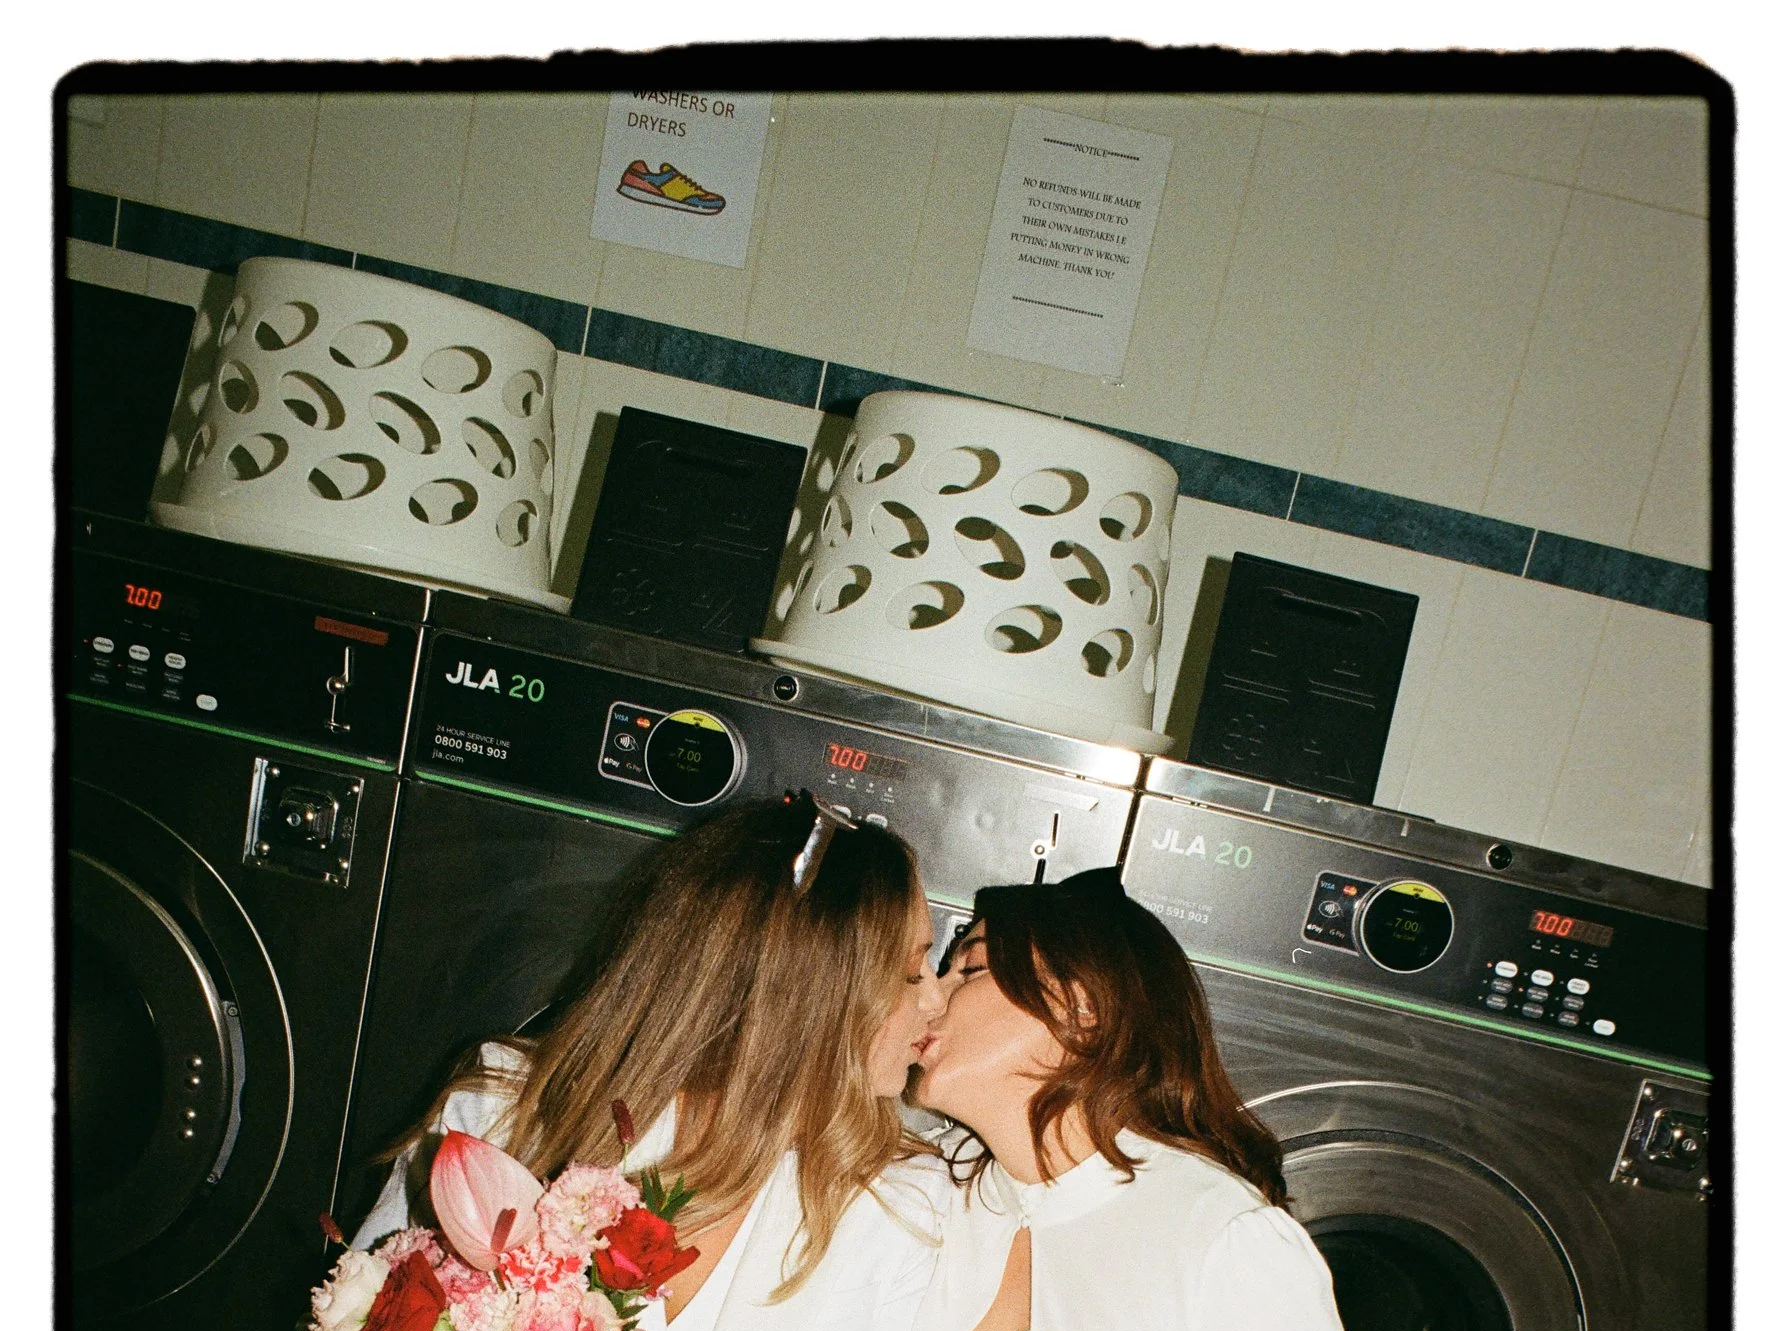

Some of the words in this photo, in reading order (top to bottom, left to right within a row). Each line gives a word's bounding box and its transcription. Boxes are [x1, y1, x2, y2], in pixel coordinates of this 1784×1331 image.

[633, 89, 707, 112] WASHERS
[713, 101, 735, 118] OR
[627, 112, 687, 137] DRYERS
[1022, 177, 1037, 187] NO
[1039, 180, 1078, 196] REFUNDS
[1079, 189, 1100, 201] WILL
[1102, 194, 1113, 204] BE
[1114, 196, 1142, 209] MADE
[1027, 197, 1041, 208] TO
[1042, 199, 1094, 219] CUSTOMERS
[1095, 211, 1114, 223] DUE
[1116, 216, 1128, 226] TO
[1022, 215, 1046, 228] THEIR
[1048, 221, 1072, 233] OWN
[1073, 226, 1115, 242] MISTAKES
[1010, 232, 1048, 248] PUTTING
[1049, 240, 1082, 254] MONEY
[1083, 247, 1094, 257] IN
[1096, 249, 1130, 265] WRONG
[1063, 262, 1093, 276] THANK
[125, 583, 162, 610] 7.00
[445, 661, 500, 693] JLA
[508, 674, 545, 702] 20
[614, 712, 629, 723] VISA
[435, 735, 463, 750] 0800
[465, 741, 484, 755] 591
[485, 746, 507, 760] 903
[446, 727, 466, 739] HOUR
[467, 731, 495, 745] SERVICE
[496, 739, 511, 748] LINE
[432, 748, 464, 764] jla.com
[677, 747, 701, 763] 7.00
[830, 745, 867, 771] 7.00
[1151, 828, 1206, 857] JLA
[1214, 841, 1252, 869] 20
[1320, 880, 1335, 890] VISA
[1166, 905, 1185, 919] 591
[1187, 911, 1209, 925] 903
[1394, 917, 1419, 933] 7.00
[1535, 911, 1573, 936] 7.00
